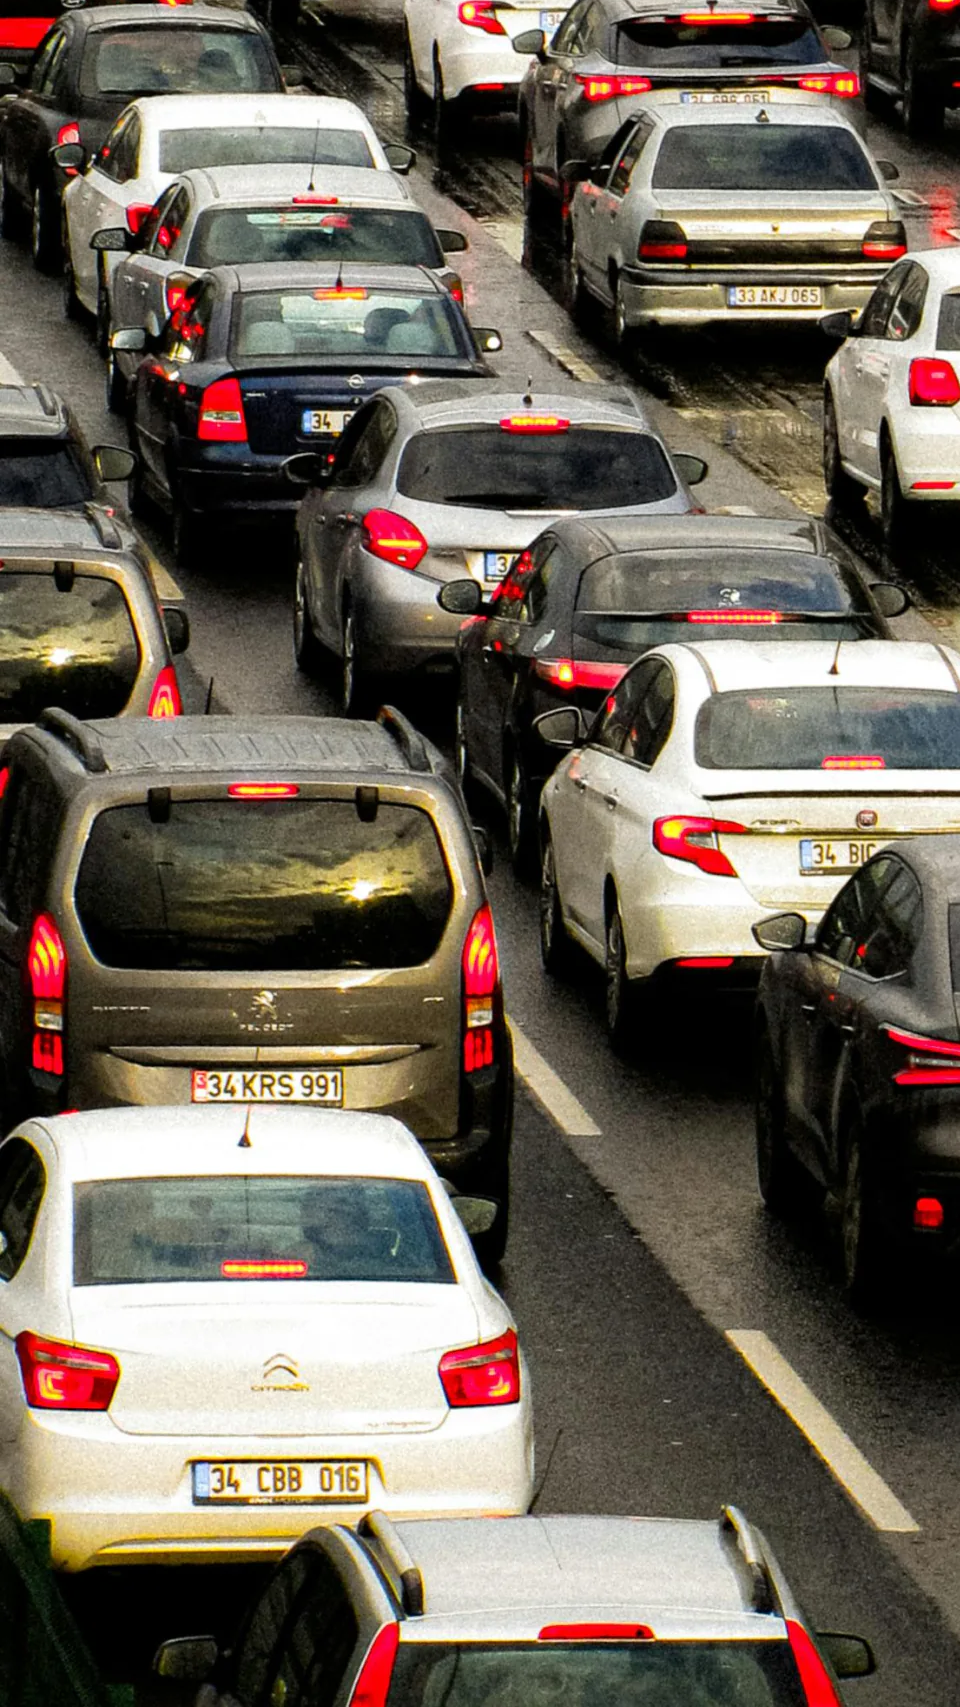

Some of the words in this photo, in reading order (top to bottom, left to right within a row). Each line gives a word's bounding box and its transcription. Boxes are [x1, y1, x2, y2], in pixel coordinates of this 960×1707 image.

[738, 289, 755, 303] 33
[761, 289, 787, 303] AKJ
[791, 288, 819, 303] 065
[312, 413, 332, 430] 34
[813, 844, 836, 865] 34
[208, 1074, 237, 1097] 34
[242, 1074, 293, 1097] KRS
[301, 1074, 339, 1097] 991
[211, 1466, 240, 1493] 34
[257, 1466, 302, 1493] CBB
[319, 1466, 360, 1492] 016
